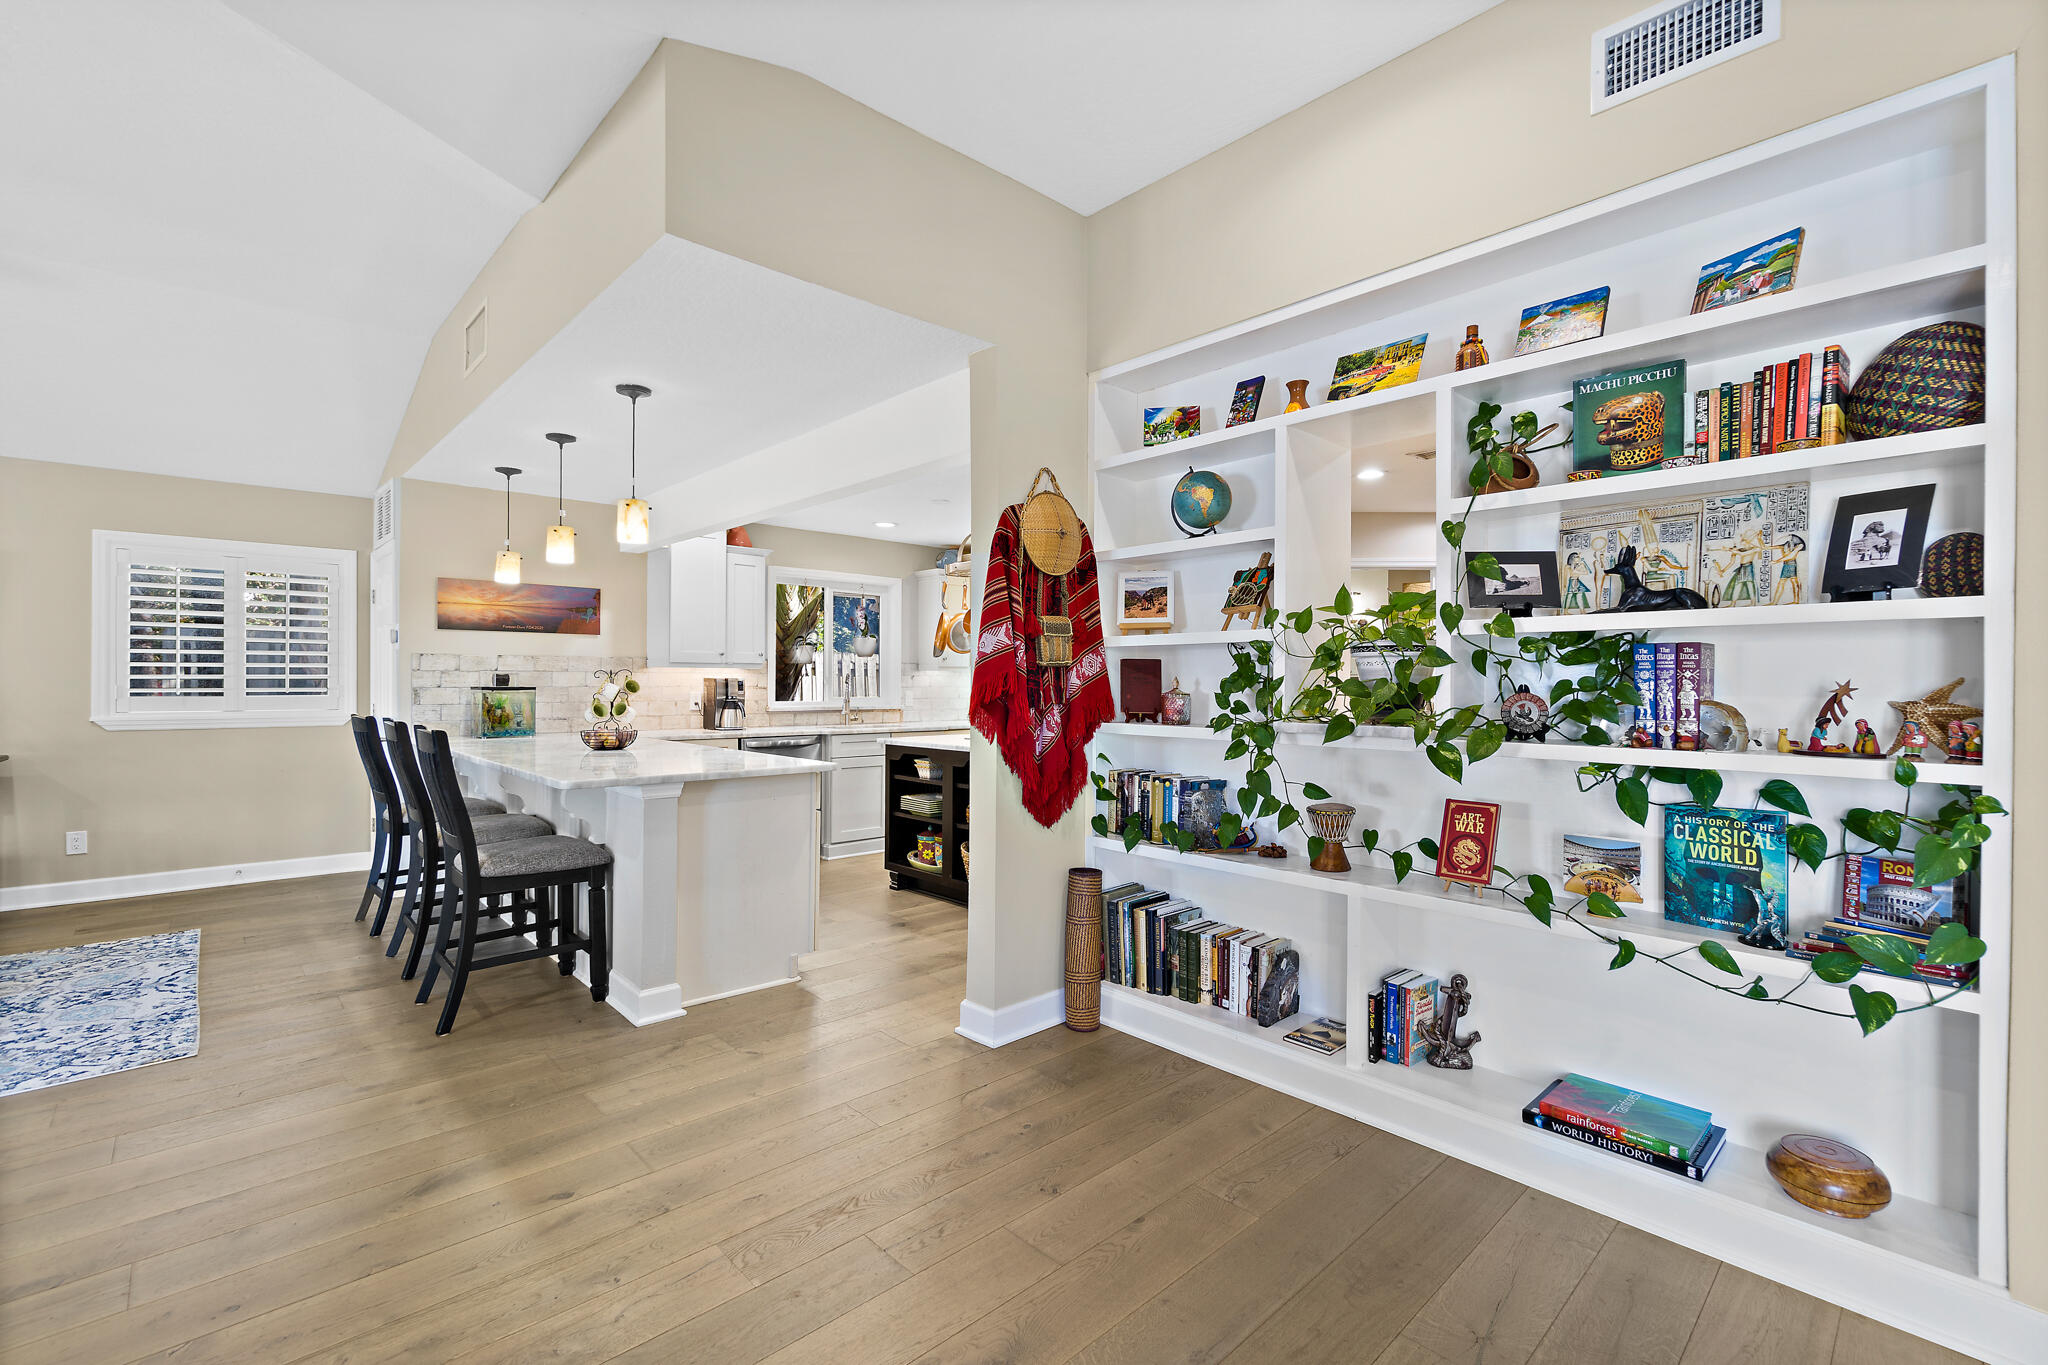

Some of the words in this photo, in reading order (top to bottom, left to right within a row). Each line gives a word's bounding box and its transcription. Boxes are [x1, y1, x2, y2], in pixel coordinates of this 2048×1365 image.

[1579, 376, 1626, 395] MACHU
[1627, 367, 1677, 386] PICCHU
[1721, 397, 1729, 426] TROPICAL
[1810, 400, 1818, 423] ANCIENT
[1809, 424, 1817, 438] MEXI
[1455, 820, 1484, 834] WAR
[1461, 812, 1481, 822] ART
[1674, 815, 1681, 823] A
[1684, 817, 1730, 827] HISTORY
[1734, 821, 1748, 829] OF
[1753, 823, 1775, 832] THE
[1673, 823, 1776, 850] CLASSICAL
[1689, 843, 1757, 866] WORLD
[1882, 861, 1914, 875] ROM
[1700, 916, 1729, 926] ELIZABETH
[1566, 1114, 1616, 1137] rainforest
[1551, 1121, 1594, 1143] WORLD
[1598, 1136, 1650, 1162] HISTORY
